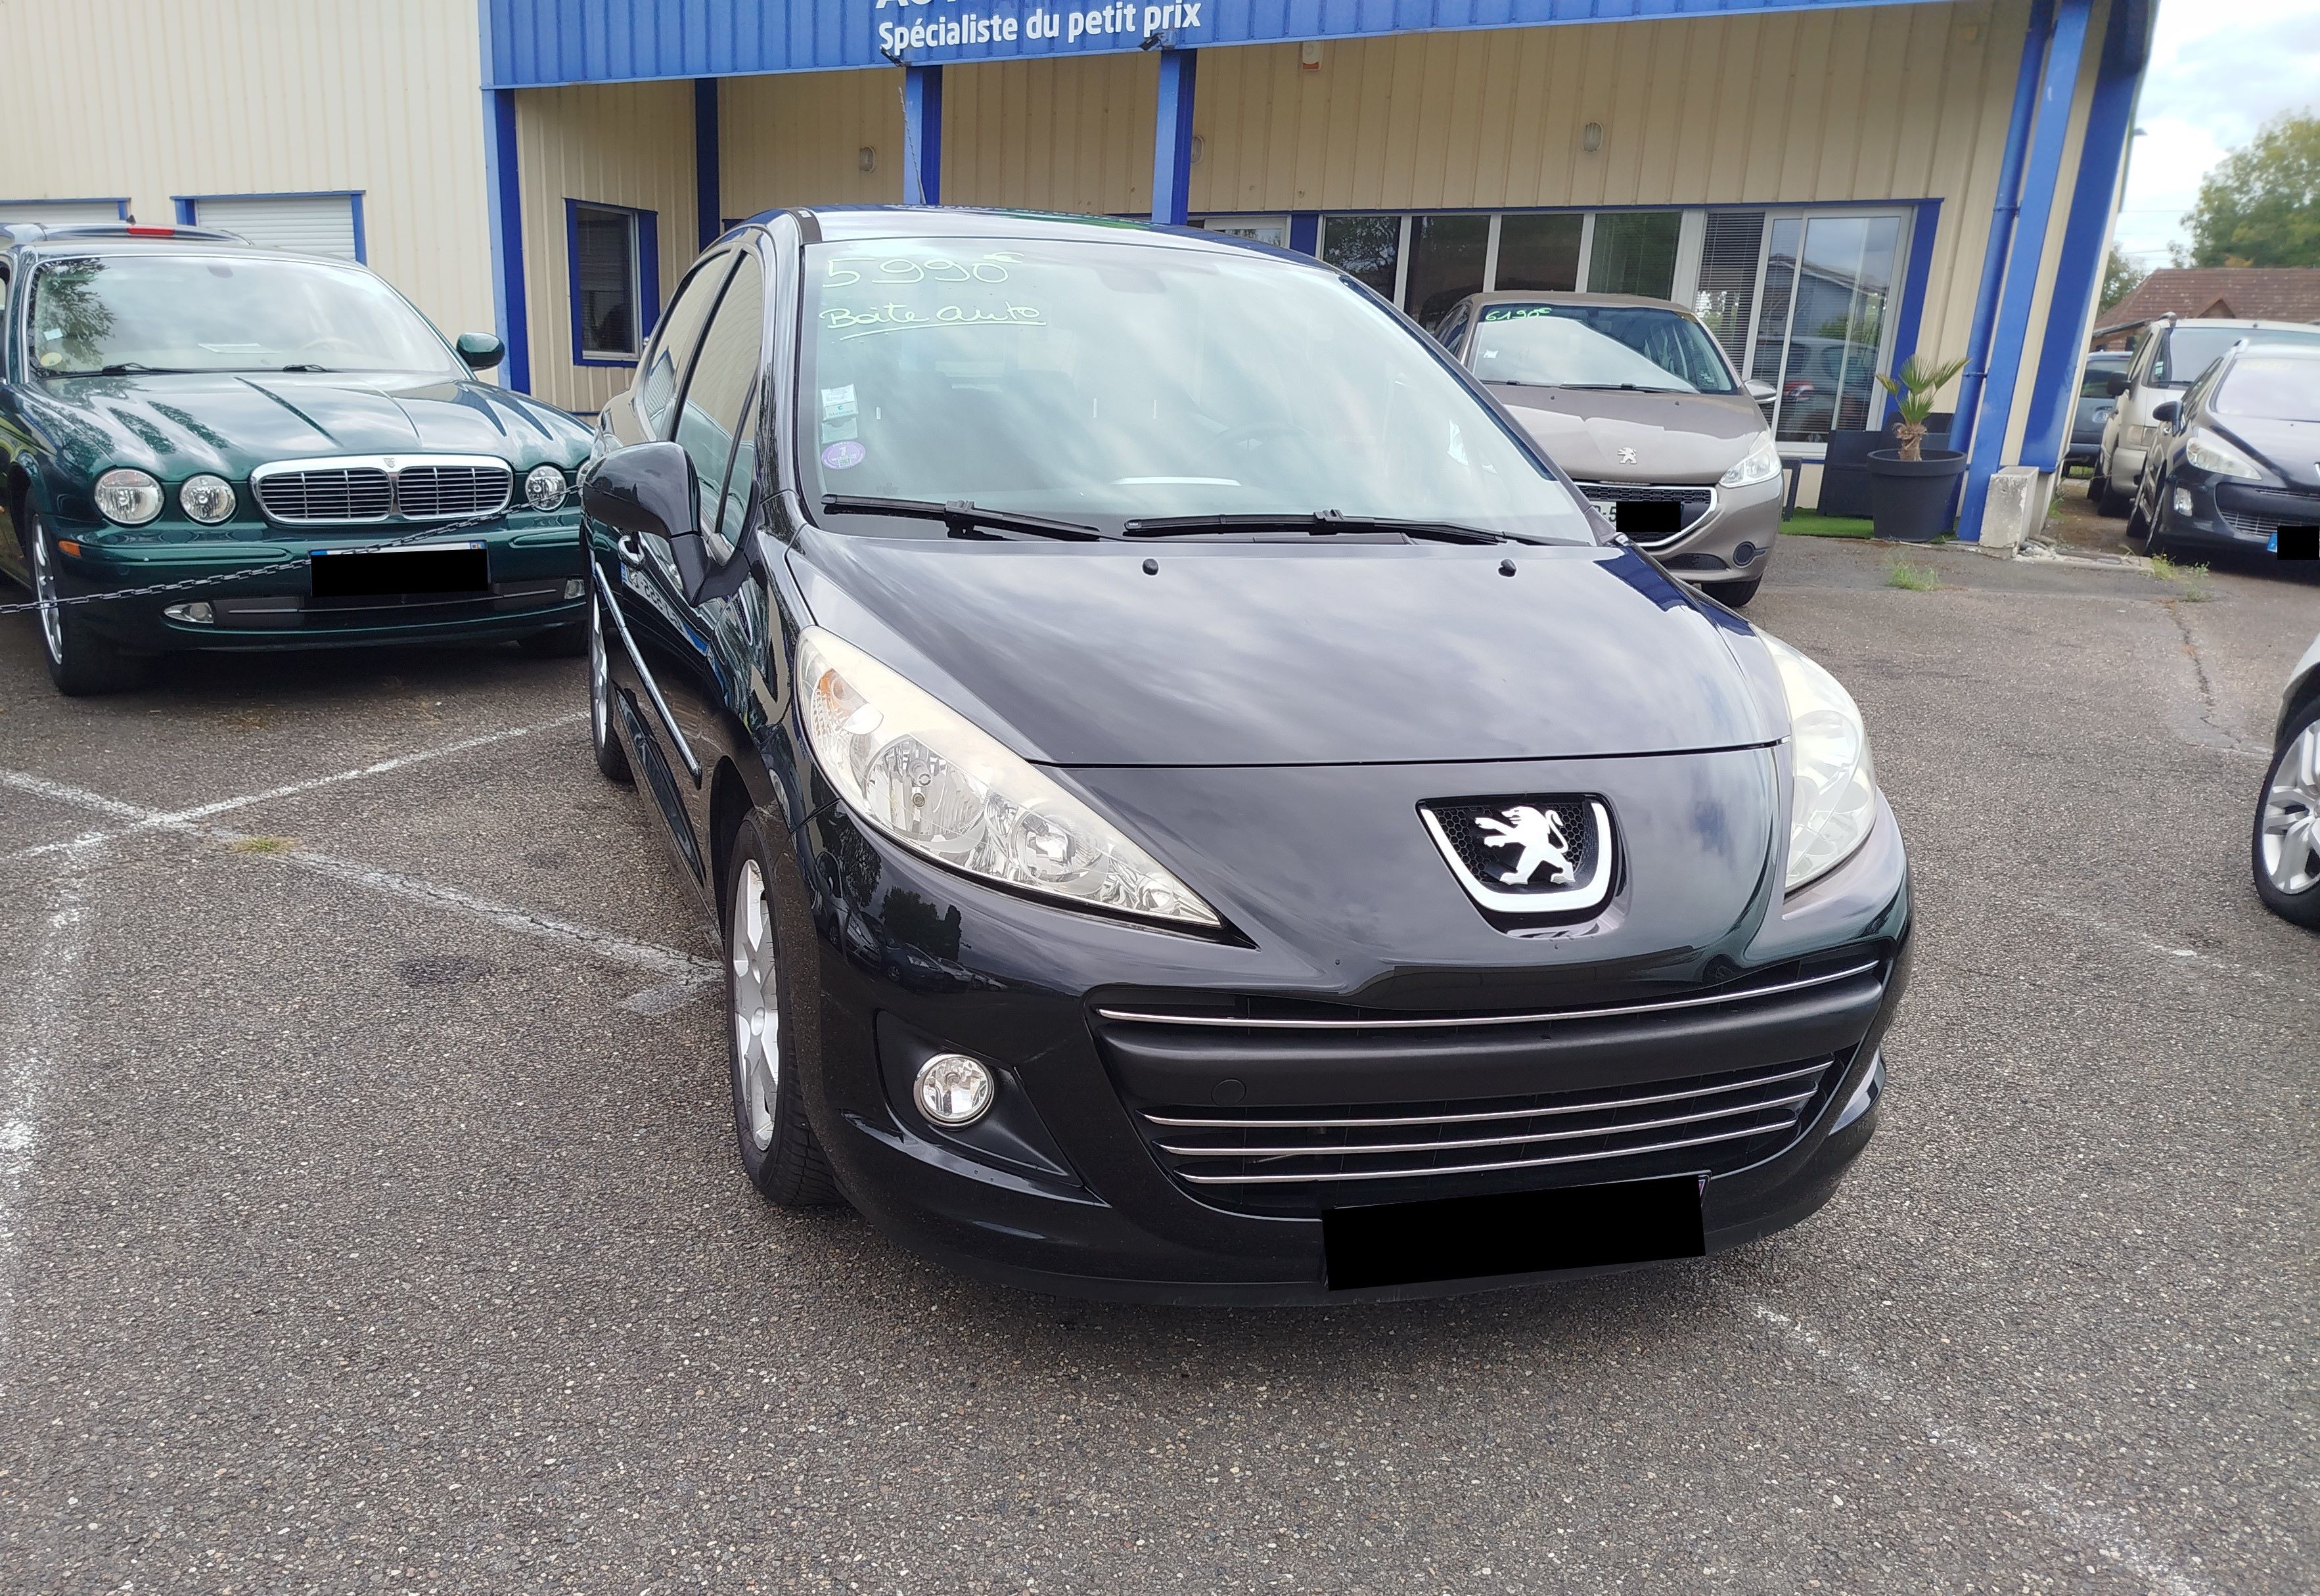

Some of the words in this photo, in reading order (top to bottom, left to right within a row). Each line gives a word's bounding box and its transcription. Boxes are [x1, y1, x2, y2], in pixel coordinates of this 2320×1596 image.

[878, 14, 1018, 57] Spécialiste
[1026, 9, 1060, 39] du
[1068, 1, 1137, 43] petit
[1143, 0, 1202, 37] prix
